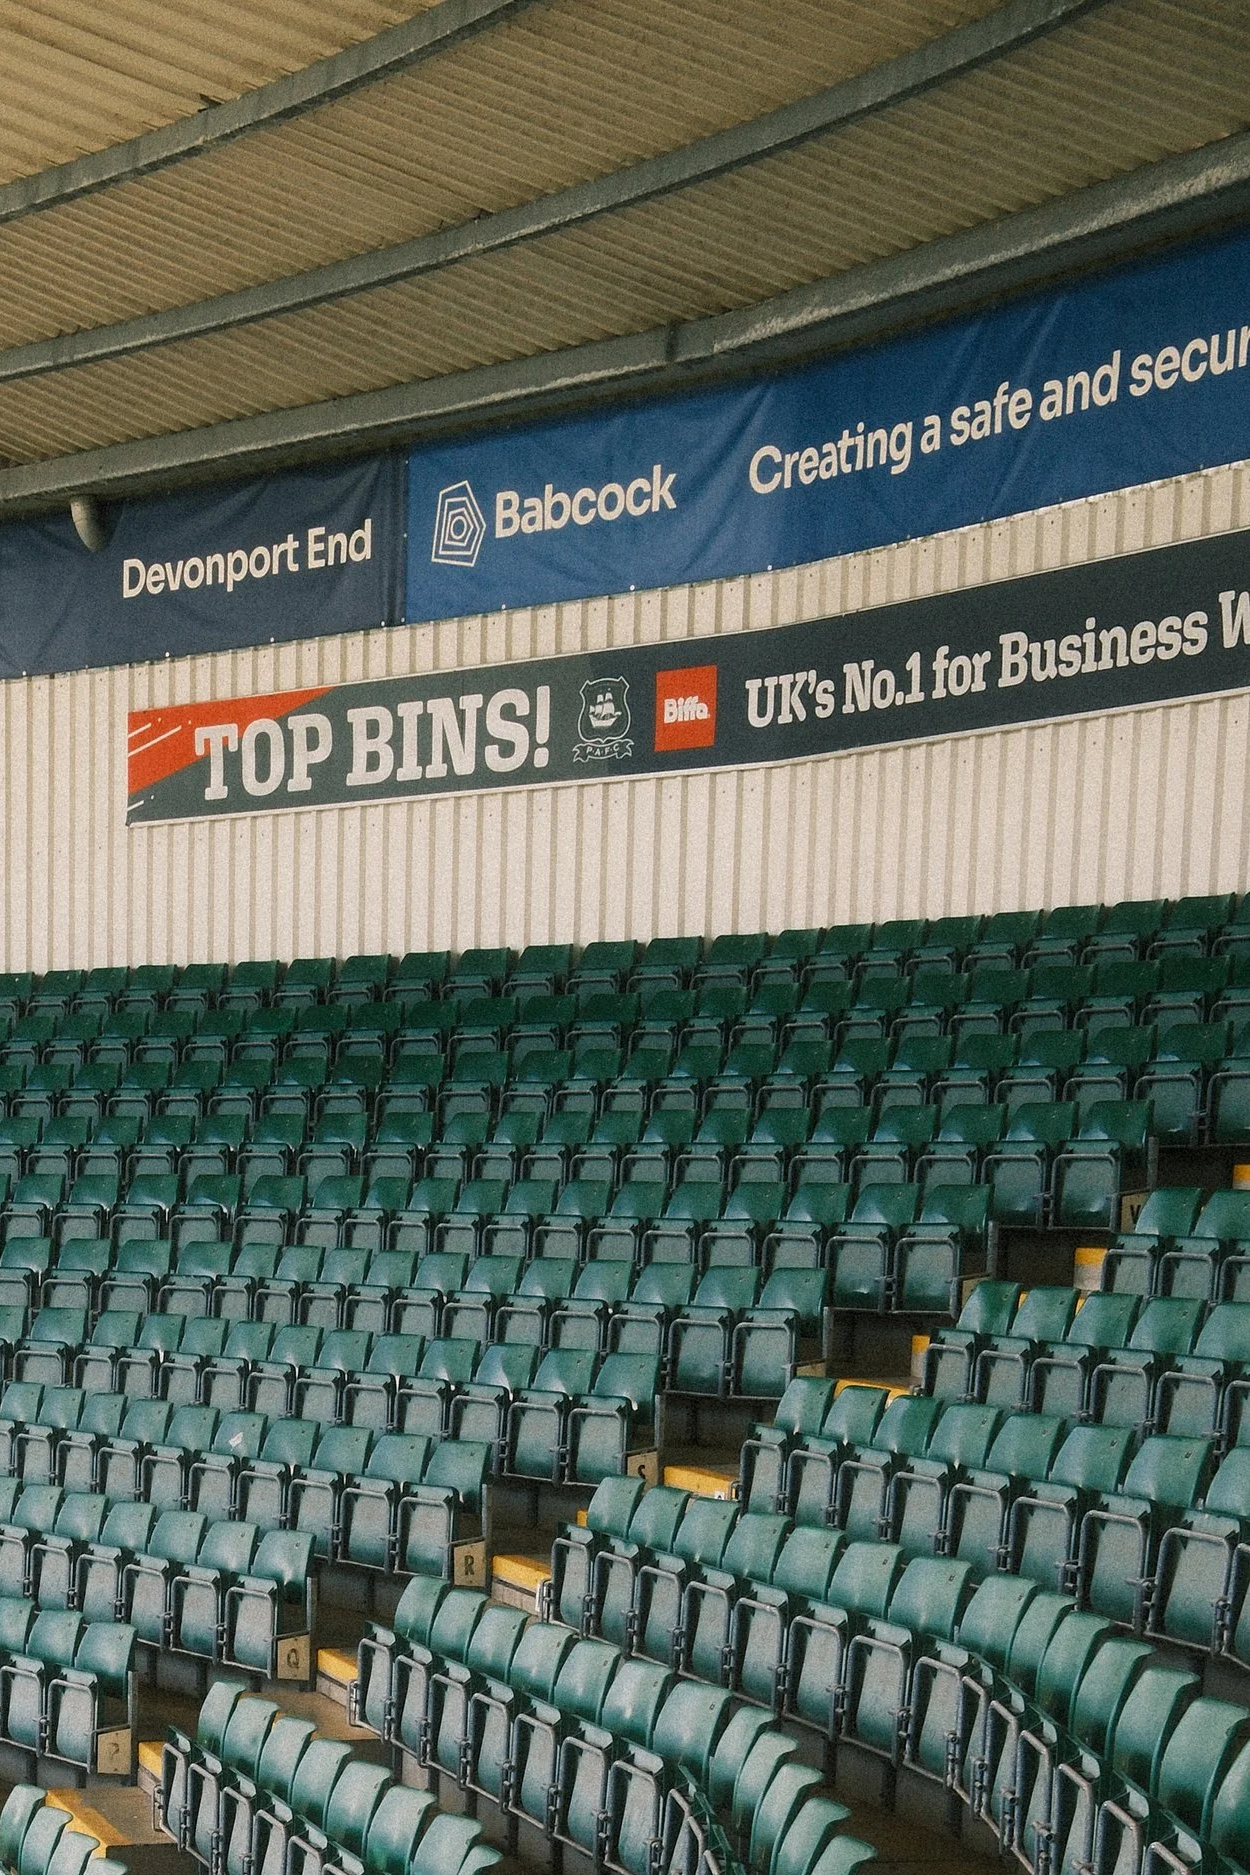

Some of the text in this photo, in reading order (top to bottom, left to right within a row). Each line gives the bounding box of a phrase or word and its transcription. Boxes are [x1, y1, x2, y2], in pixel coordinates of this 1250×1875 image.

[749, 420, 914, 496] Creating
[920, 414, 942, 455] a
[949, 381, 1033, 447] safe
[1038, 349, 1121, 421] and
[494, 463, 678, 540] Babcock
[121, 518, 374, 600] Devonport End
[841, 651, 927, 716] No.1
[931, 644, 992, 698] for
[997, 610, 1209, 688] Business
[193, 684, 553, 802] TOP BINS!
[464, 1554, 475, 1576] R
